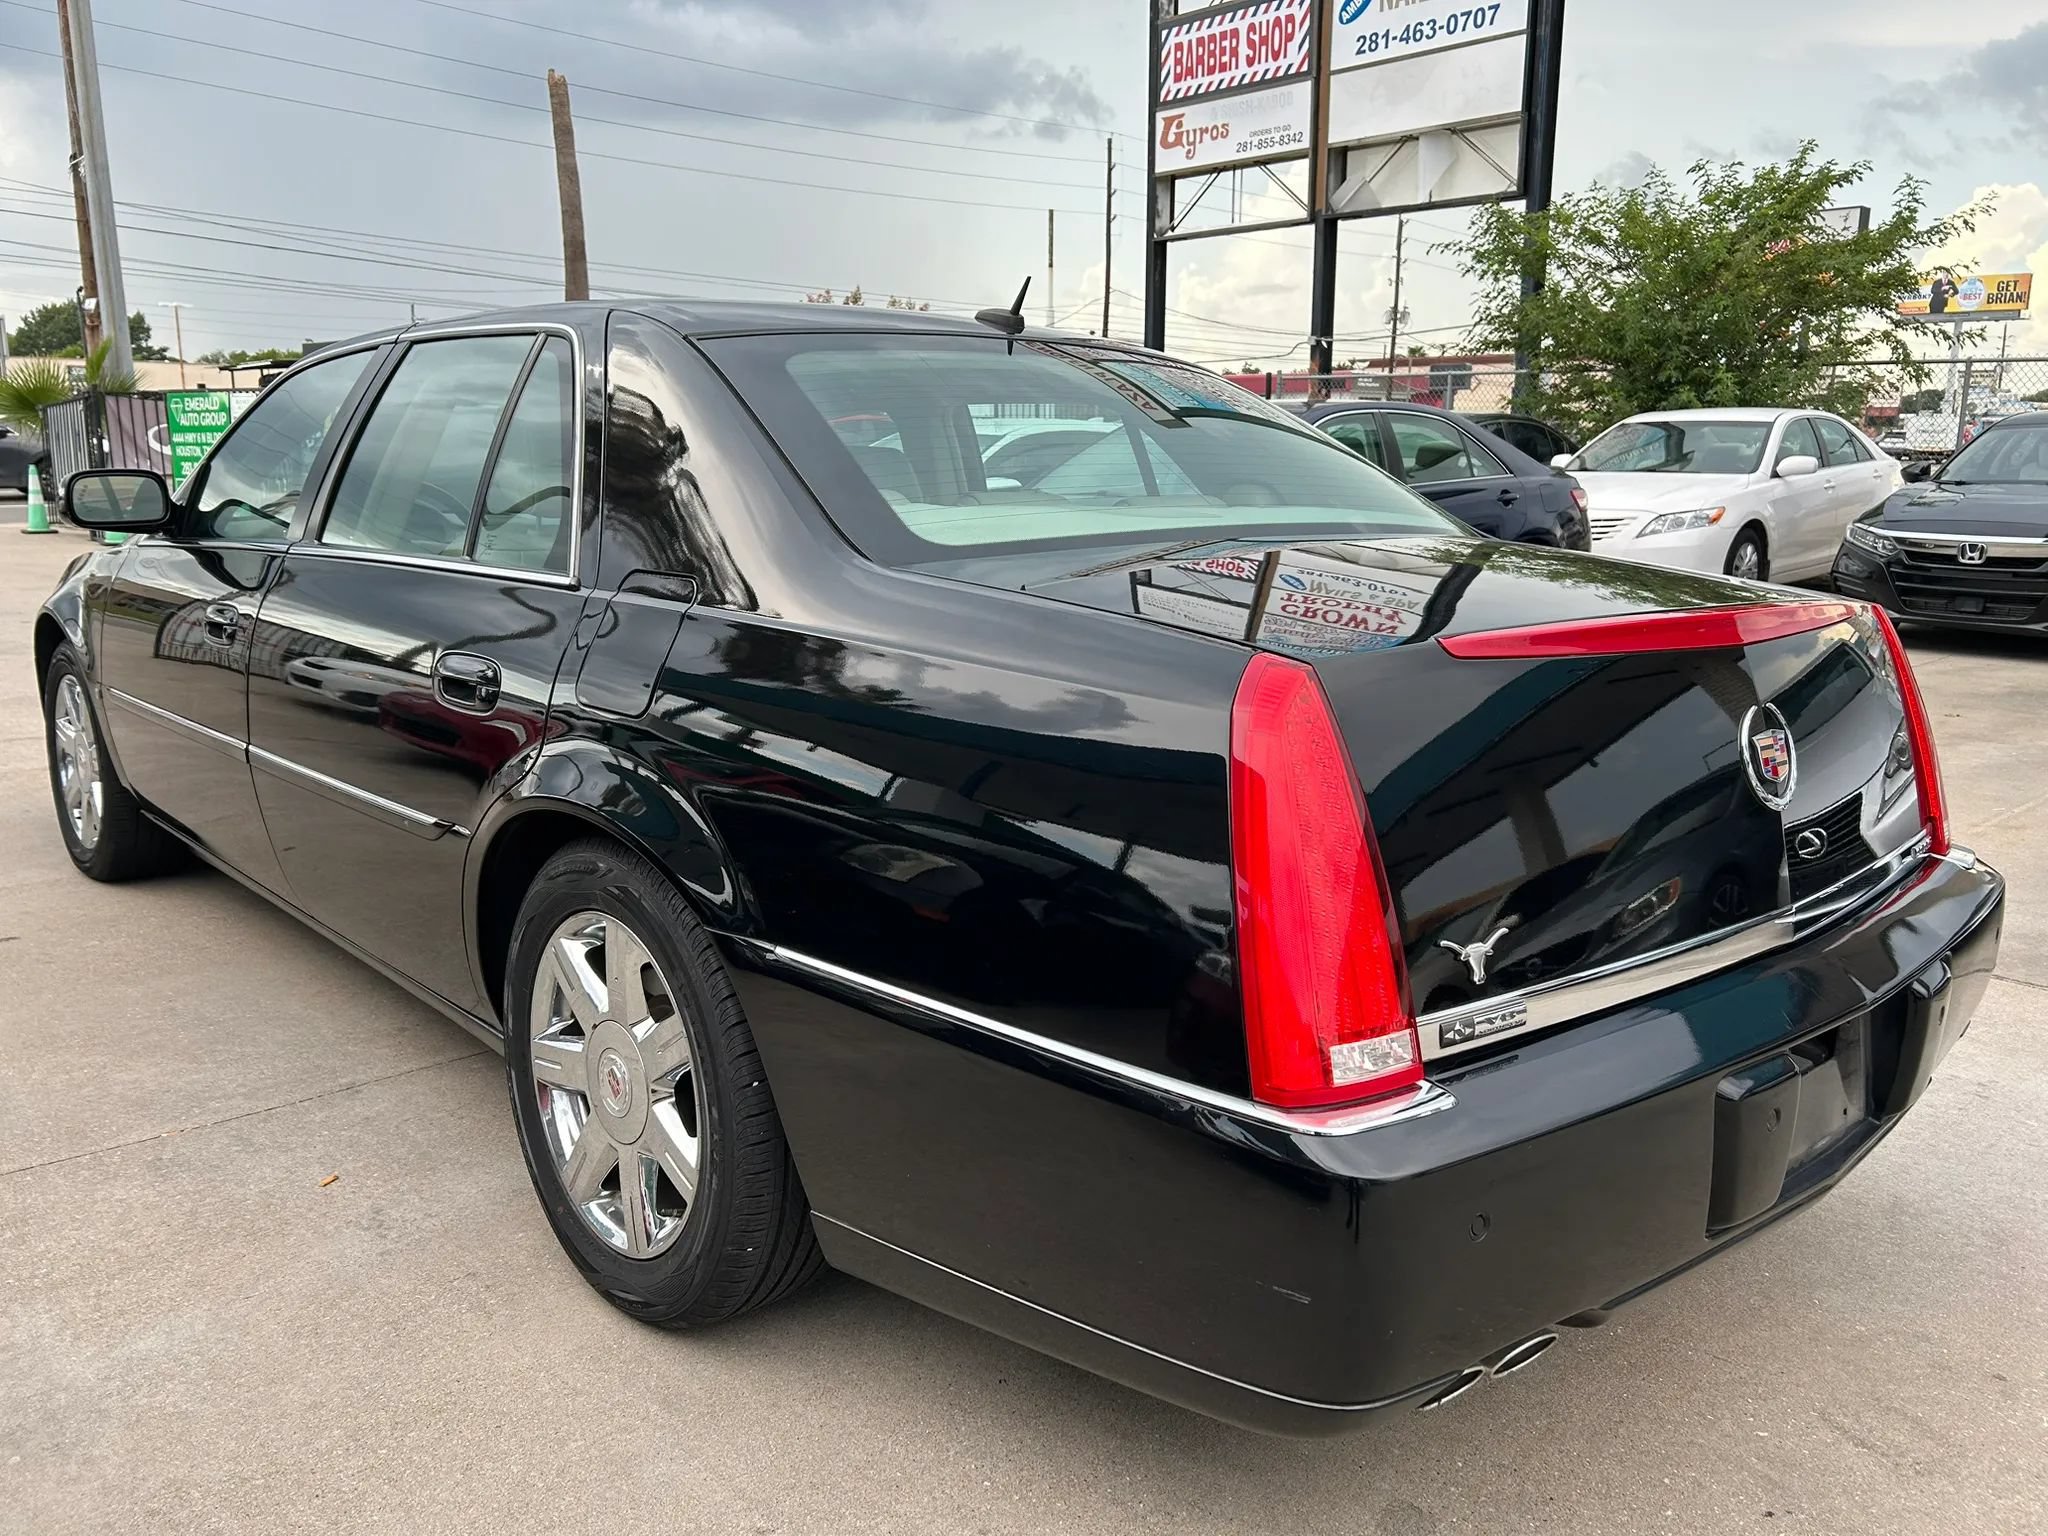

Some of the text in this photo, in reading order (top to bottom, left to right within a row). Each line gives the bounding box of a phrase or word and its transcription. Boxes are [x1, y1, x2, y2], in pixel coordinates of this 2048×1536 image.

[1355, 3, 1501, 56] 281-463-0707
[1173, 13, 1296, 84] BARBER SHOP
[1159, 113, 1230, 160] Gyros
[1249, 124, 1292, 138] ORDERS TO GO
[1236, 131, 1304, 154] 281-855-8342
[1997, 280, 2020, 292] GET
[1987, 291, 2027, 304] BRIAN!
[184, 397, 220, 411] EMERALD
[180, 412, 227, 426] AUTO GROUP
[185, 432, 196, 443] HWY
